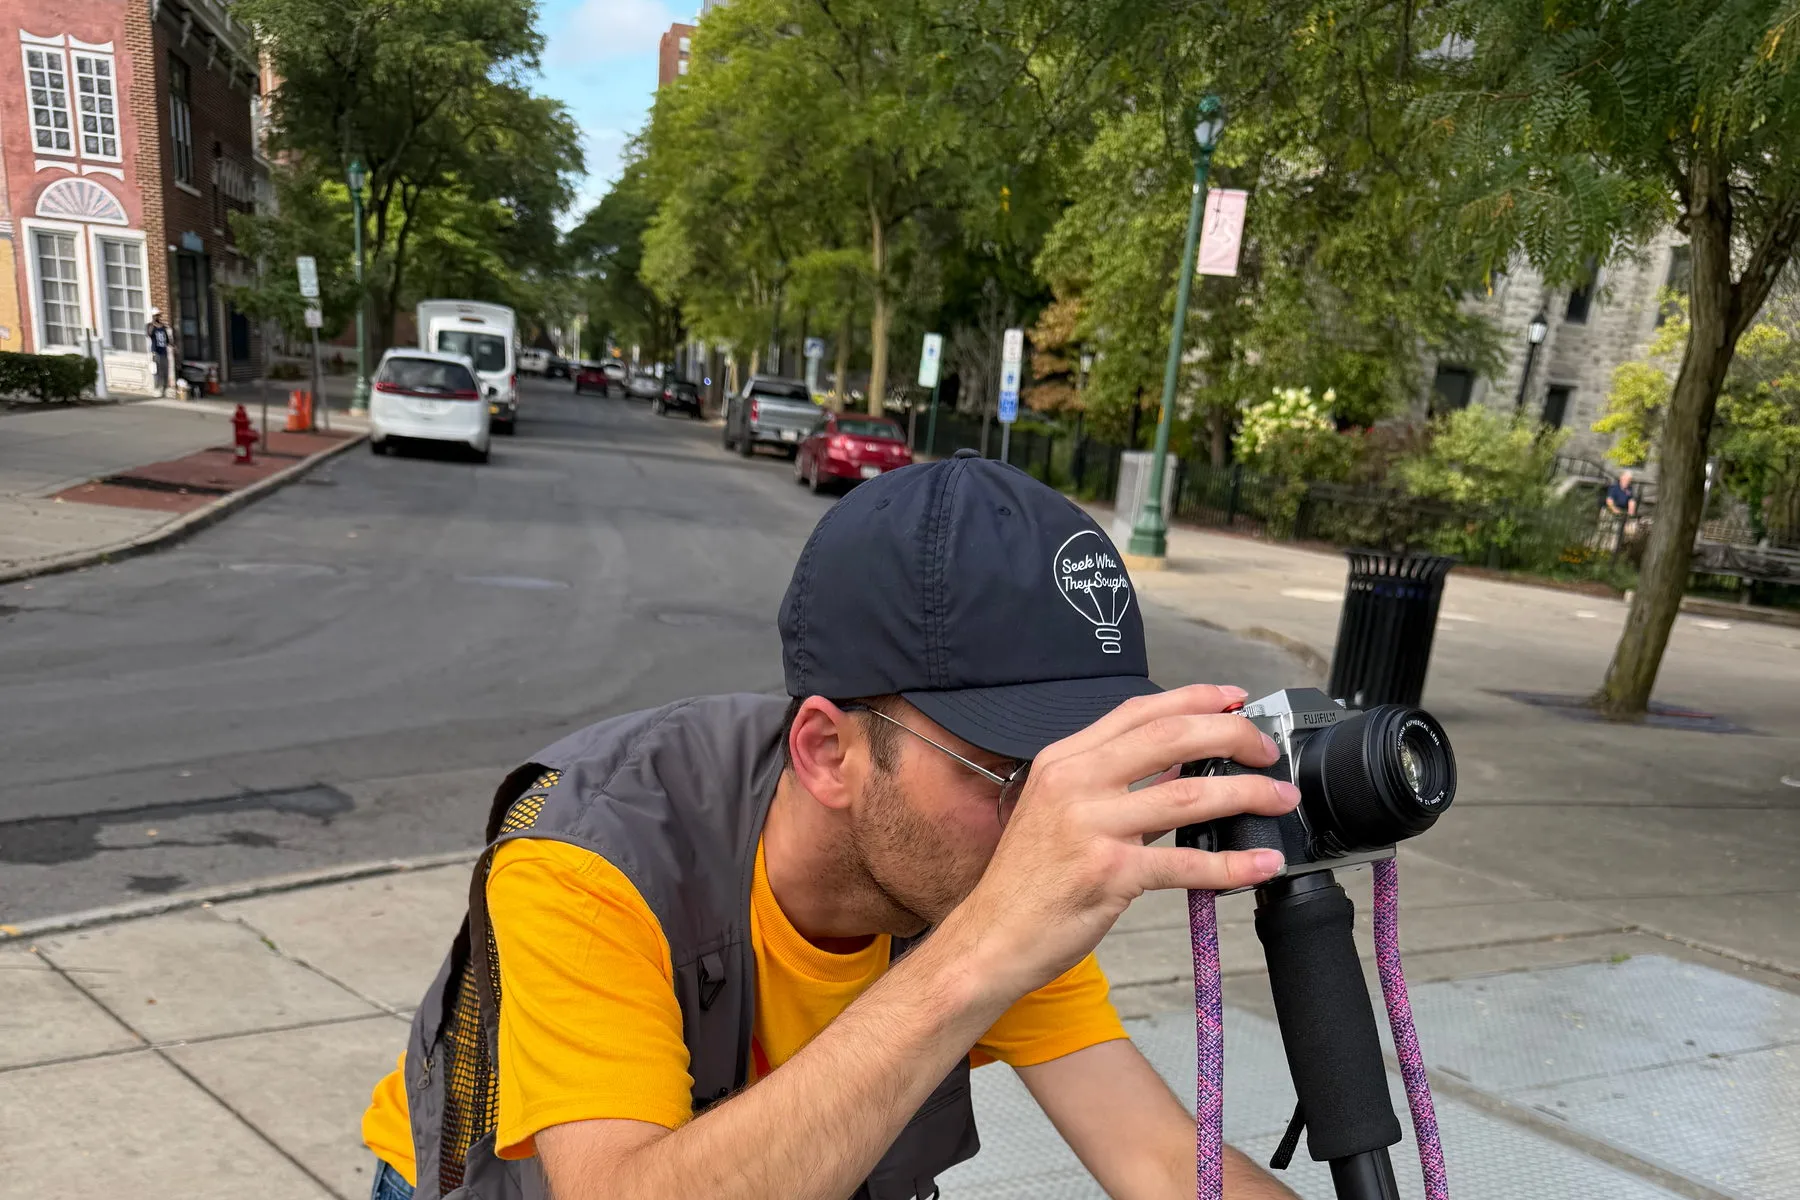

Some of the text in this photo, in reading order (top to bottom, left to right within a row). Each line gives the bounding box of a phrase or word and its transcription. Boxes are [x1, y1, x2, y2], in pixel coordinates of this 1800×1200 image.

[1062, 554, 1094, 574] Seek
[1062, 575, 1093, 594] They
[1303, 711, 1337, 725] FUJIFILM
[1429, 730, 1440, 747] LENS
